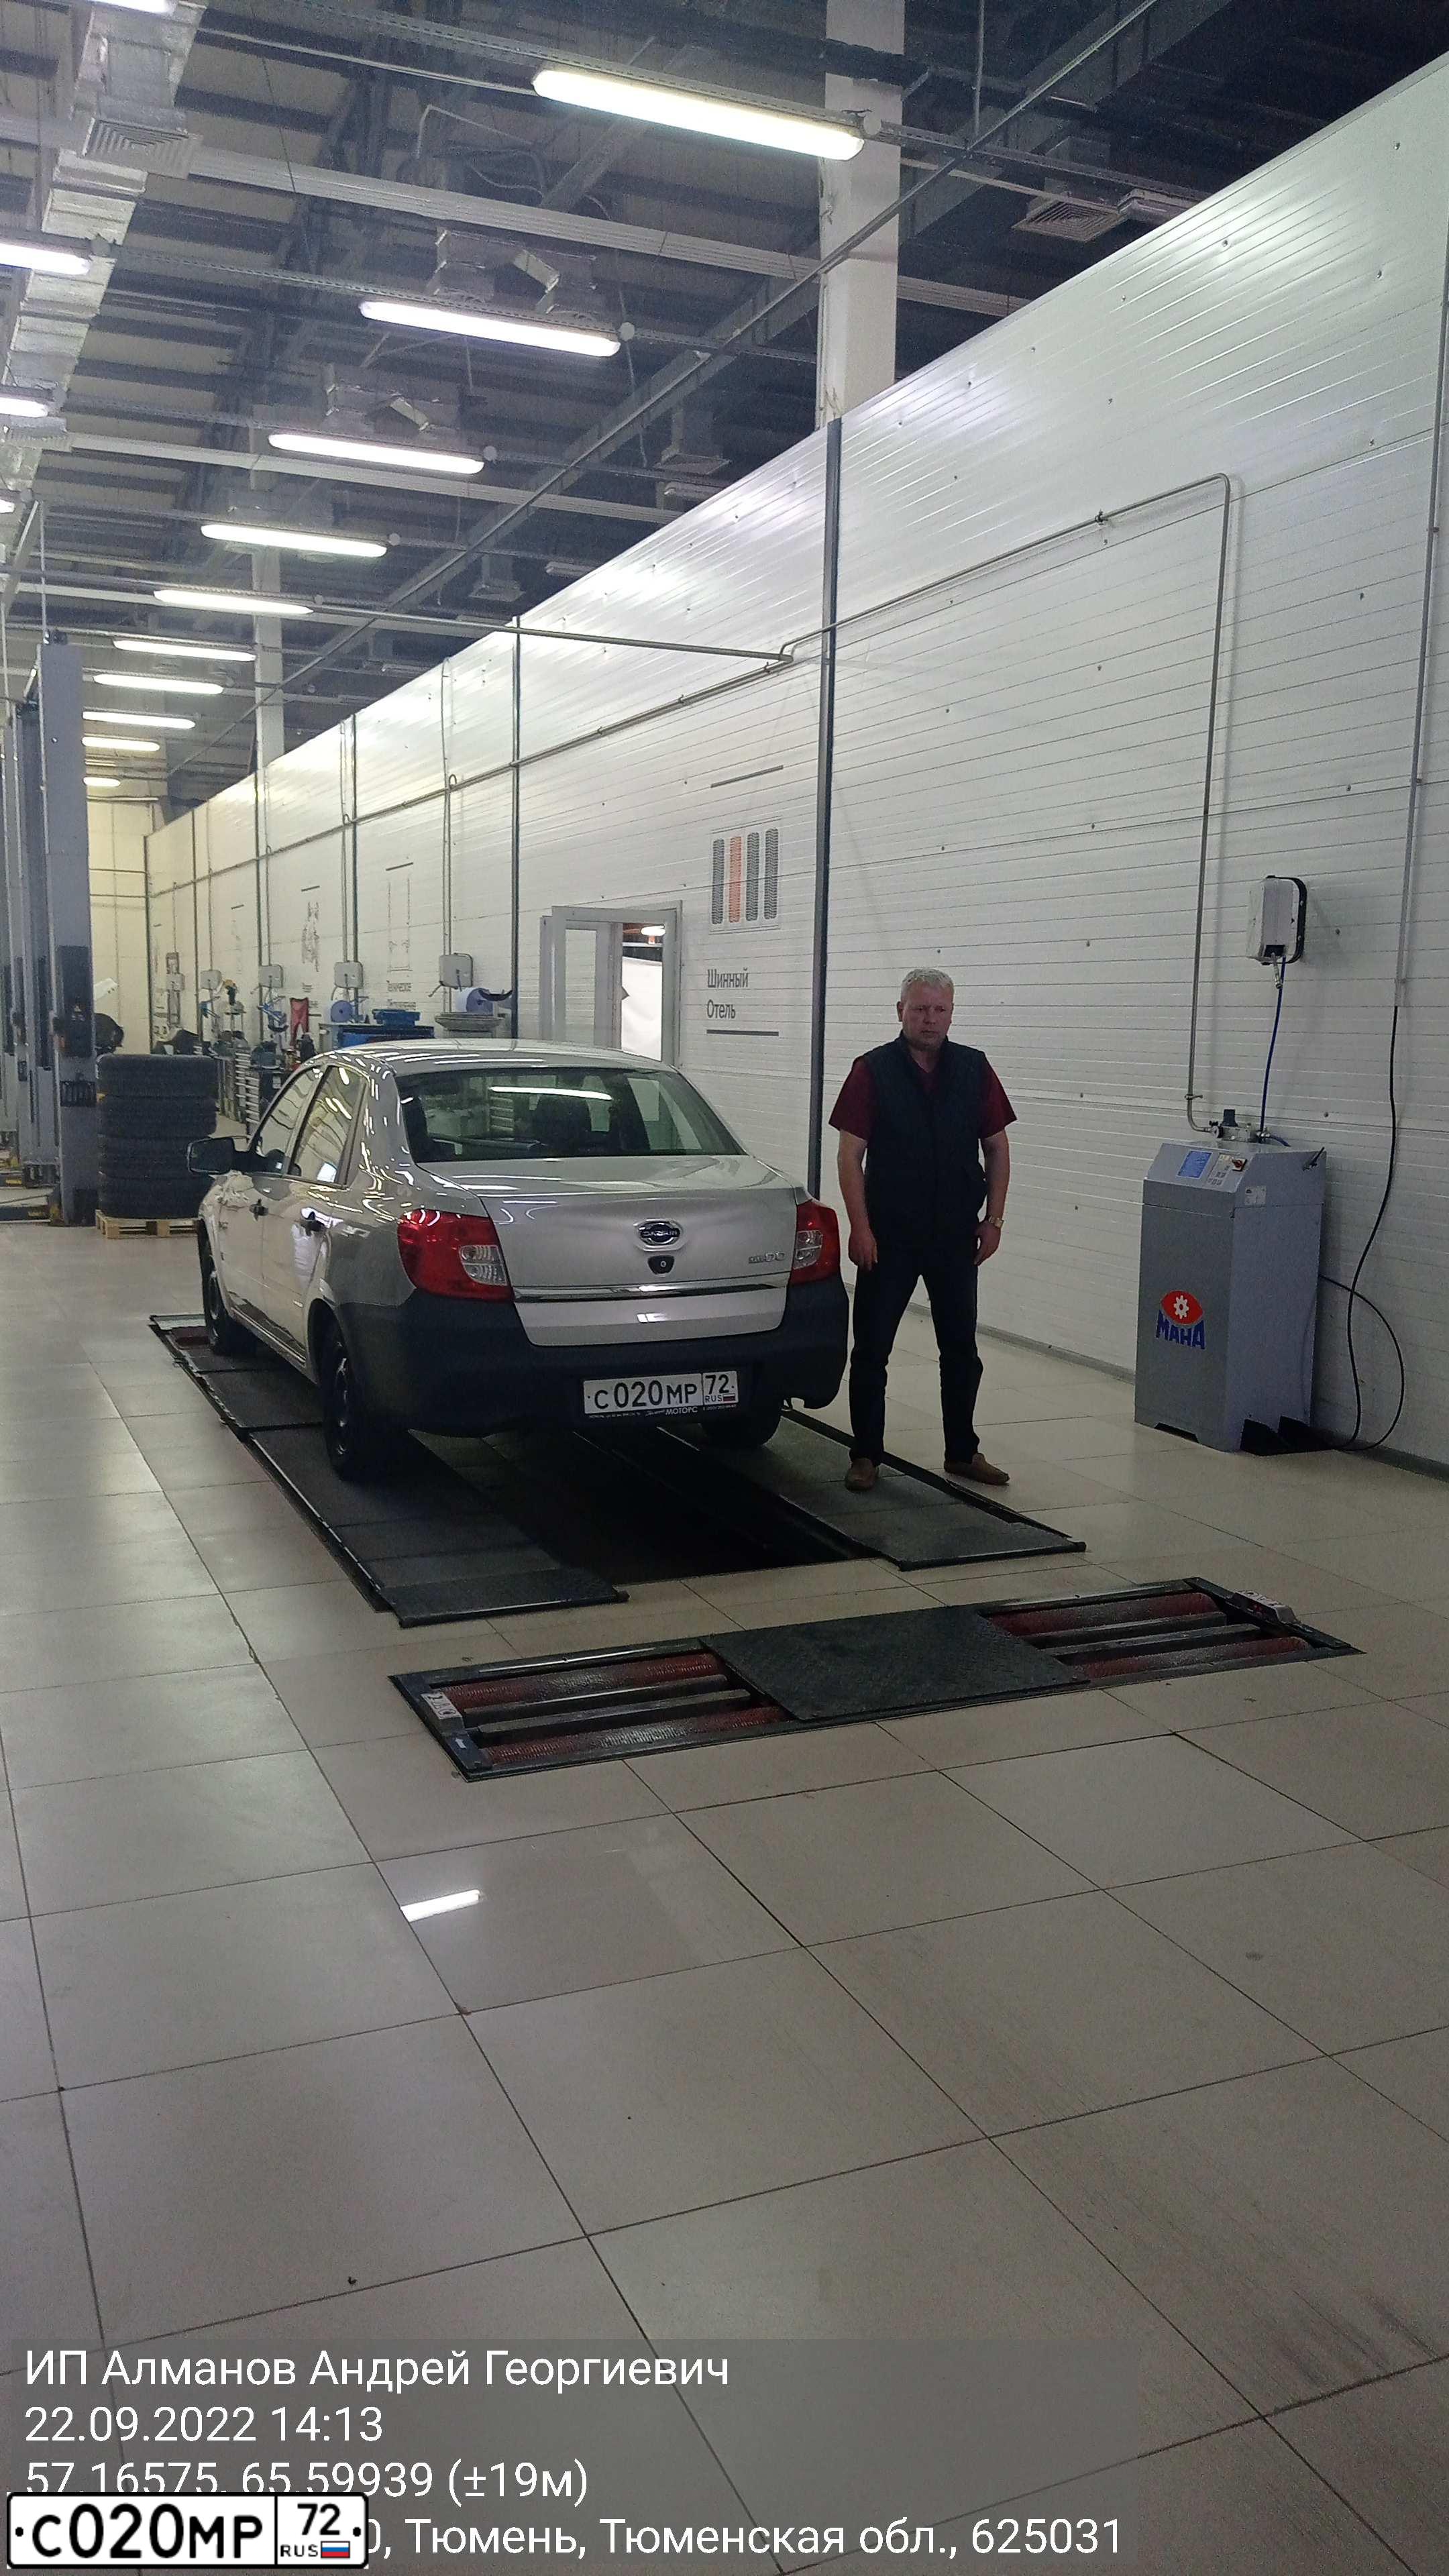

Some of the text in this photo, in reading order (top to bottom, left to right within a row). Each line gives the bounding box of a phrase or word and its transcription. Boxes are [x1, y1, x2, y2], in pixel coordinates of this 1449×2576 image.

[708, 967, 749, 988] Шинный
[707, 999, 736, 1019] Отель
[1156, 1309, 1205, 1350] MAHA
[705, 1375, 729, 1395] 72
[705, 1394, 722, 1403] RUS
